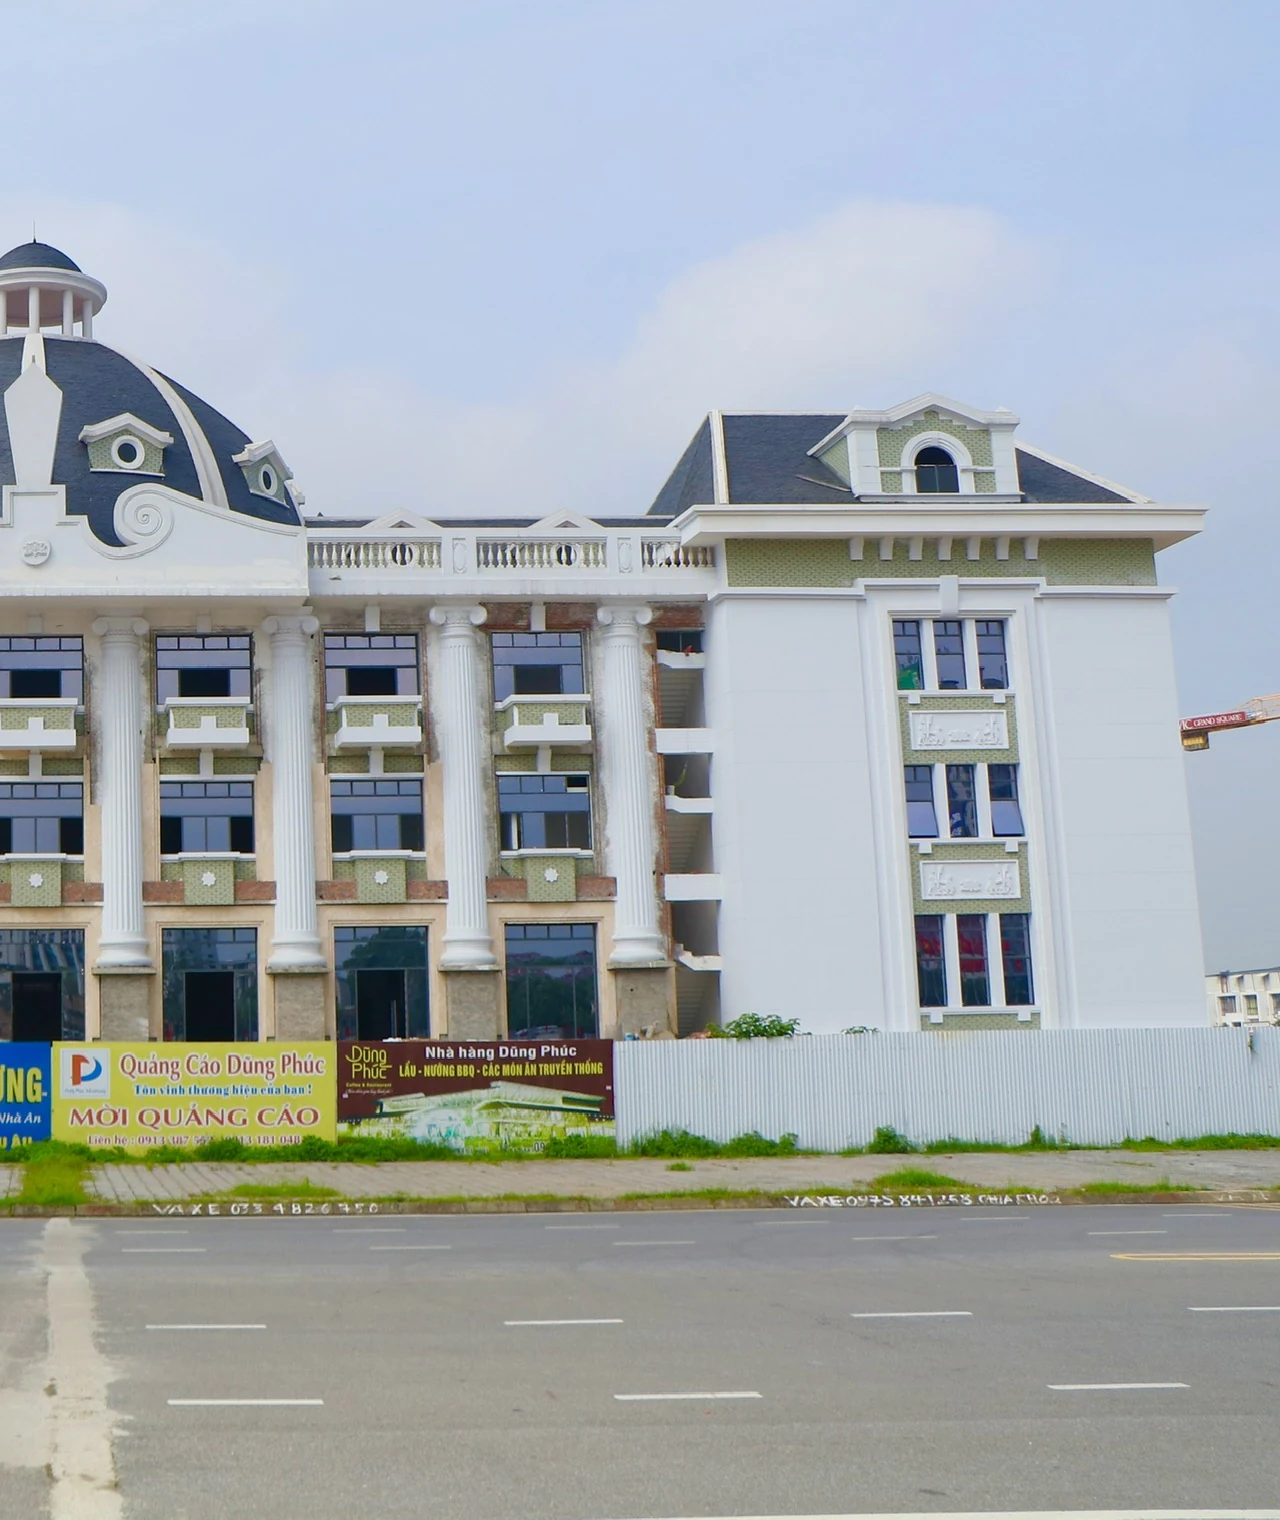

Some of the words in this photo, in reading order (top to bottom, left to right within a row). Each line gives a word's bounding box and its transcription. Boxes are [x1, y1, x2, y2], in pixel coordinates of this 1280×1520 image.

[345, 1045, 391, 1065] Dũng
[425, 1046, 454, 1059] Nhà
[459, 1046, 494, 1061] hàng
[499, 1046, 537, 1060] Dũng
[541, 1045, 577, 1057] Phúc
[120, 1053, 181, 1081] Quảng
[186, 1054, 221, 1075] Cáo
[228, 1054, 276, 1081] Dũng
[282, 1052, 325, 1074] Phúc
[352, 1063, 387, 1079] Phúc
[424, 1062, 455, 1077] NƯỚNG
[457, 1065, 475, 1078] BBQ
[482, 1062, 501, 1077] CÁC
[502, 1062, 523, 1077] MÓN
[524, 1061, 537, 1076] ĂN
[539, 1059, 573, 1076] TRUYỀN
[574, 1057, 604, 1075] THỐNG
[135, 1084, 156, 1095] Tôn
[160, 1084, 185, 1095] vinh
[188, 1084, 229, 1097] thương
[232, 1084, 258, 1098] hiệu
[260, 1082, 281, 1095] của
[284, 1084, 305, 1097] bạn
[70, 1103, 127, 1126] MỜI
[138, 1103, 248, 1130] QUẢNG
[257, 1103, 320, 1126] CÁO
[88, 1135, 111, 1145] Liên
[257, 1135, 275, 1145] 181
[280, 1135, 301, 1145] 048
